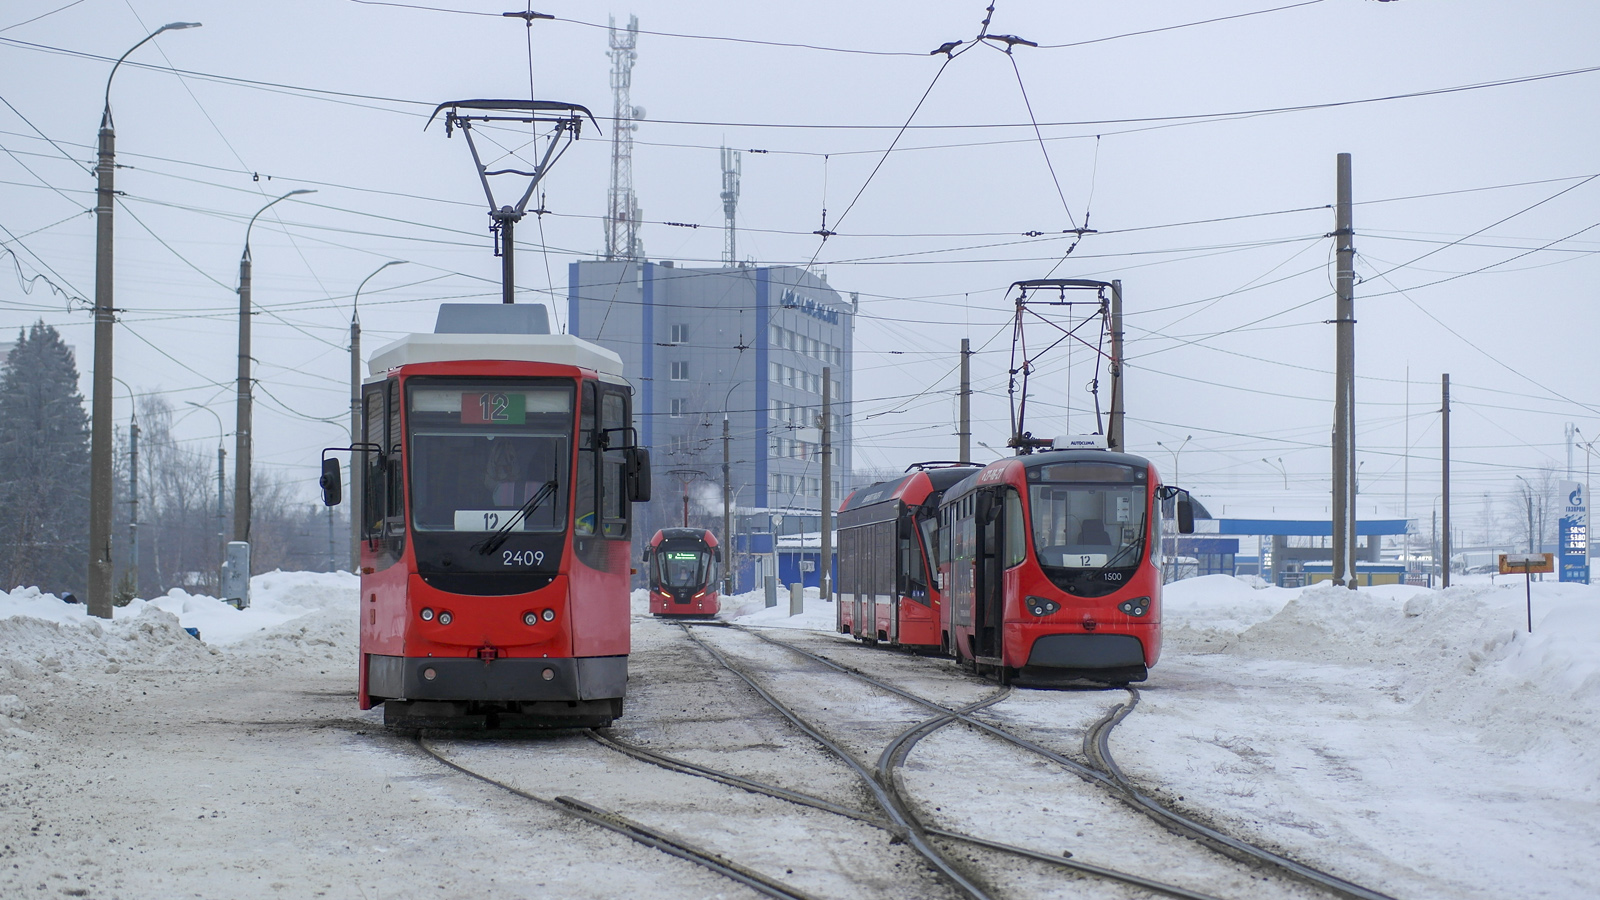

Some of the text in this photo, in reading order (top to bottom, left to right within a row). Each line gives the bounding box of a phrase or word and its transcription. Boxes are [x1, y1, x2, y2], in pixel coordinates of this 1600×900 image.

[479, 393, 509, 421] 12
[483, 512, 499, 531] 12
[502, 550, 544, 566] 2409
[1079, 555, 1091, 567] 12
[1104, 572, 1122, 581] 1500
